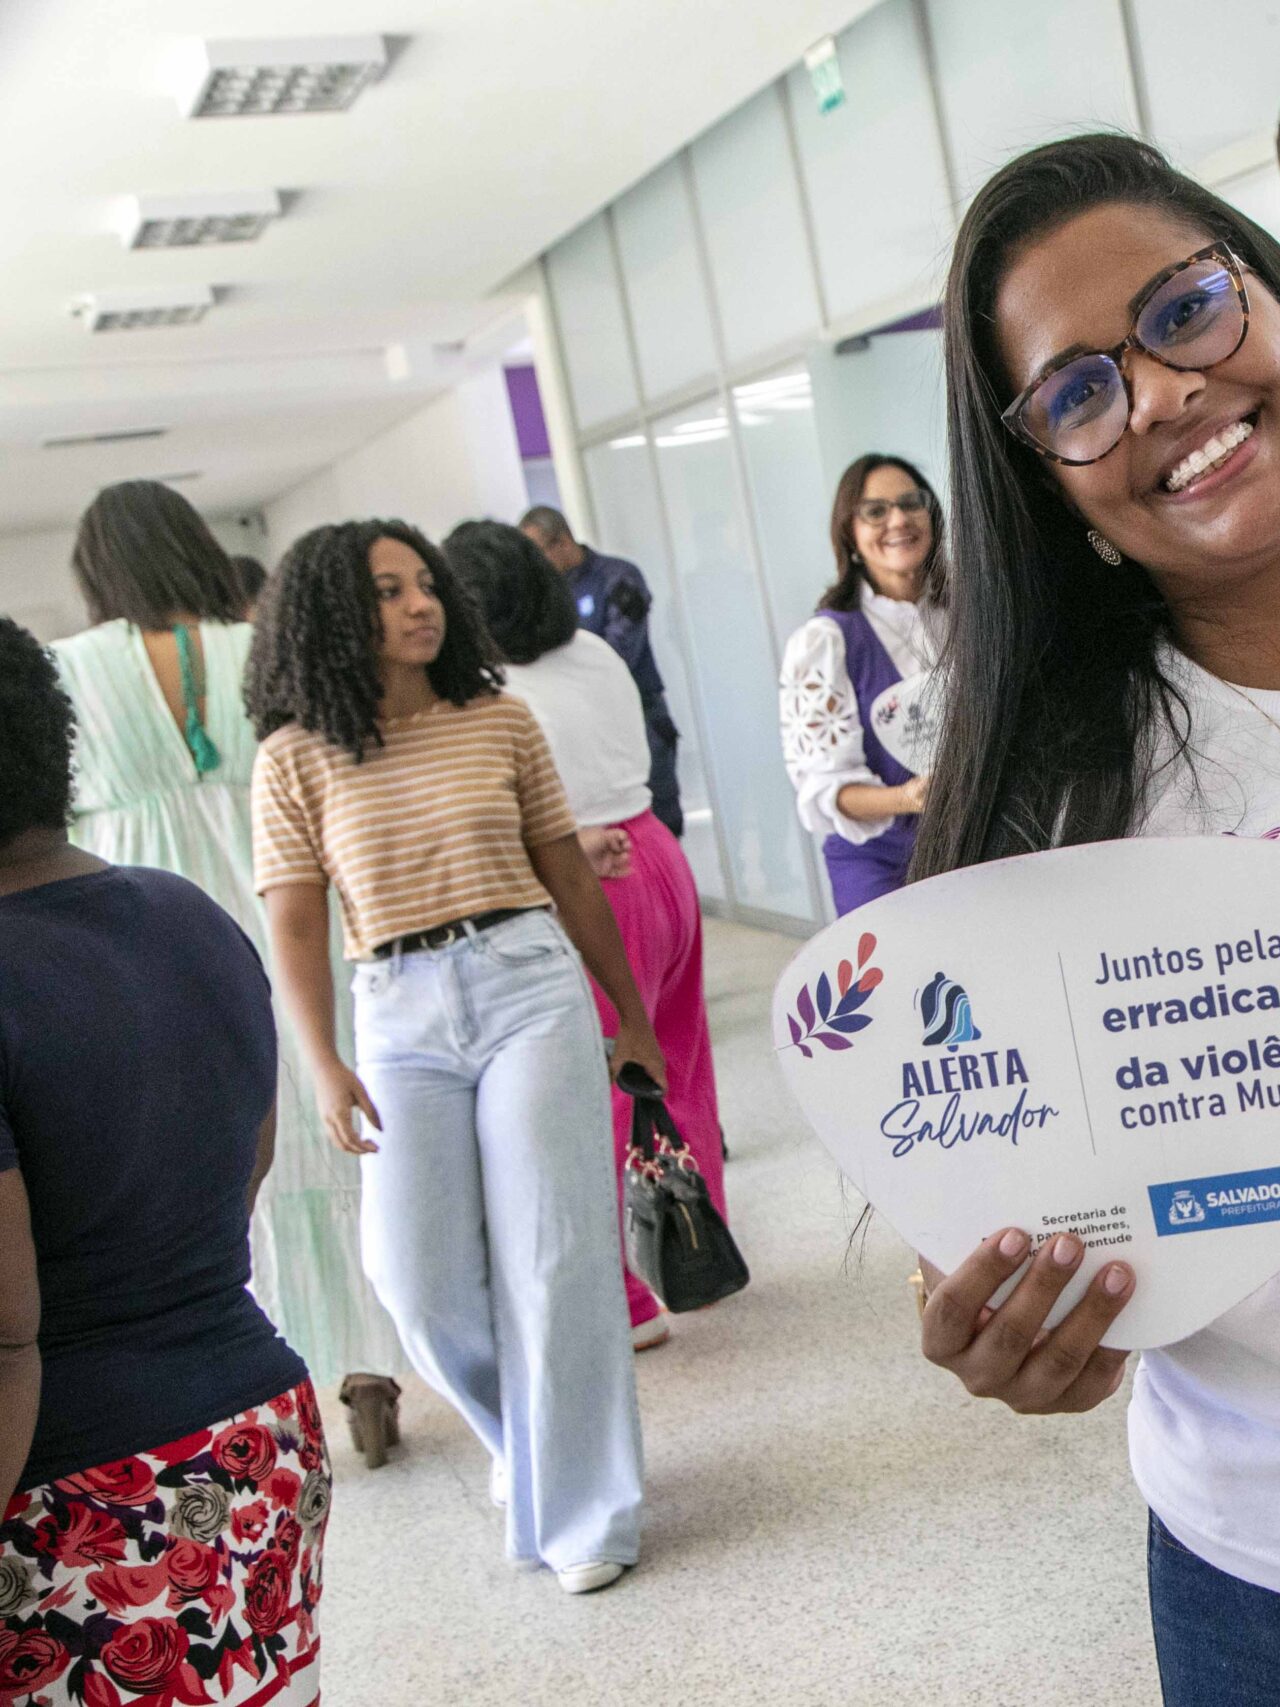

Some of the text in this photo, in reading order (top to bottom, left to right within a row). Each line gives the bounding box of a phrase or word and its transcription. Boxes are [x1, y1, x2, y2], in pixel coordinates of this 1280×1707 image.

[1096, 947, 1203, 984] Juntos
[903, 1049, 1029, 1098] ALERTA
[1116, 1057, 1169, 1090] da
[880, 1087, 1060, 1158] Salvador
[1121, 1093, 1226, 1129] contra
[1042, 1206, 1125, 1225] Secretaria de
[1069, 1222, 1129, 1237] Mulheres,
